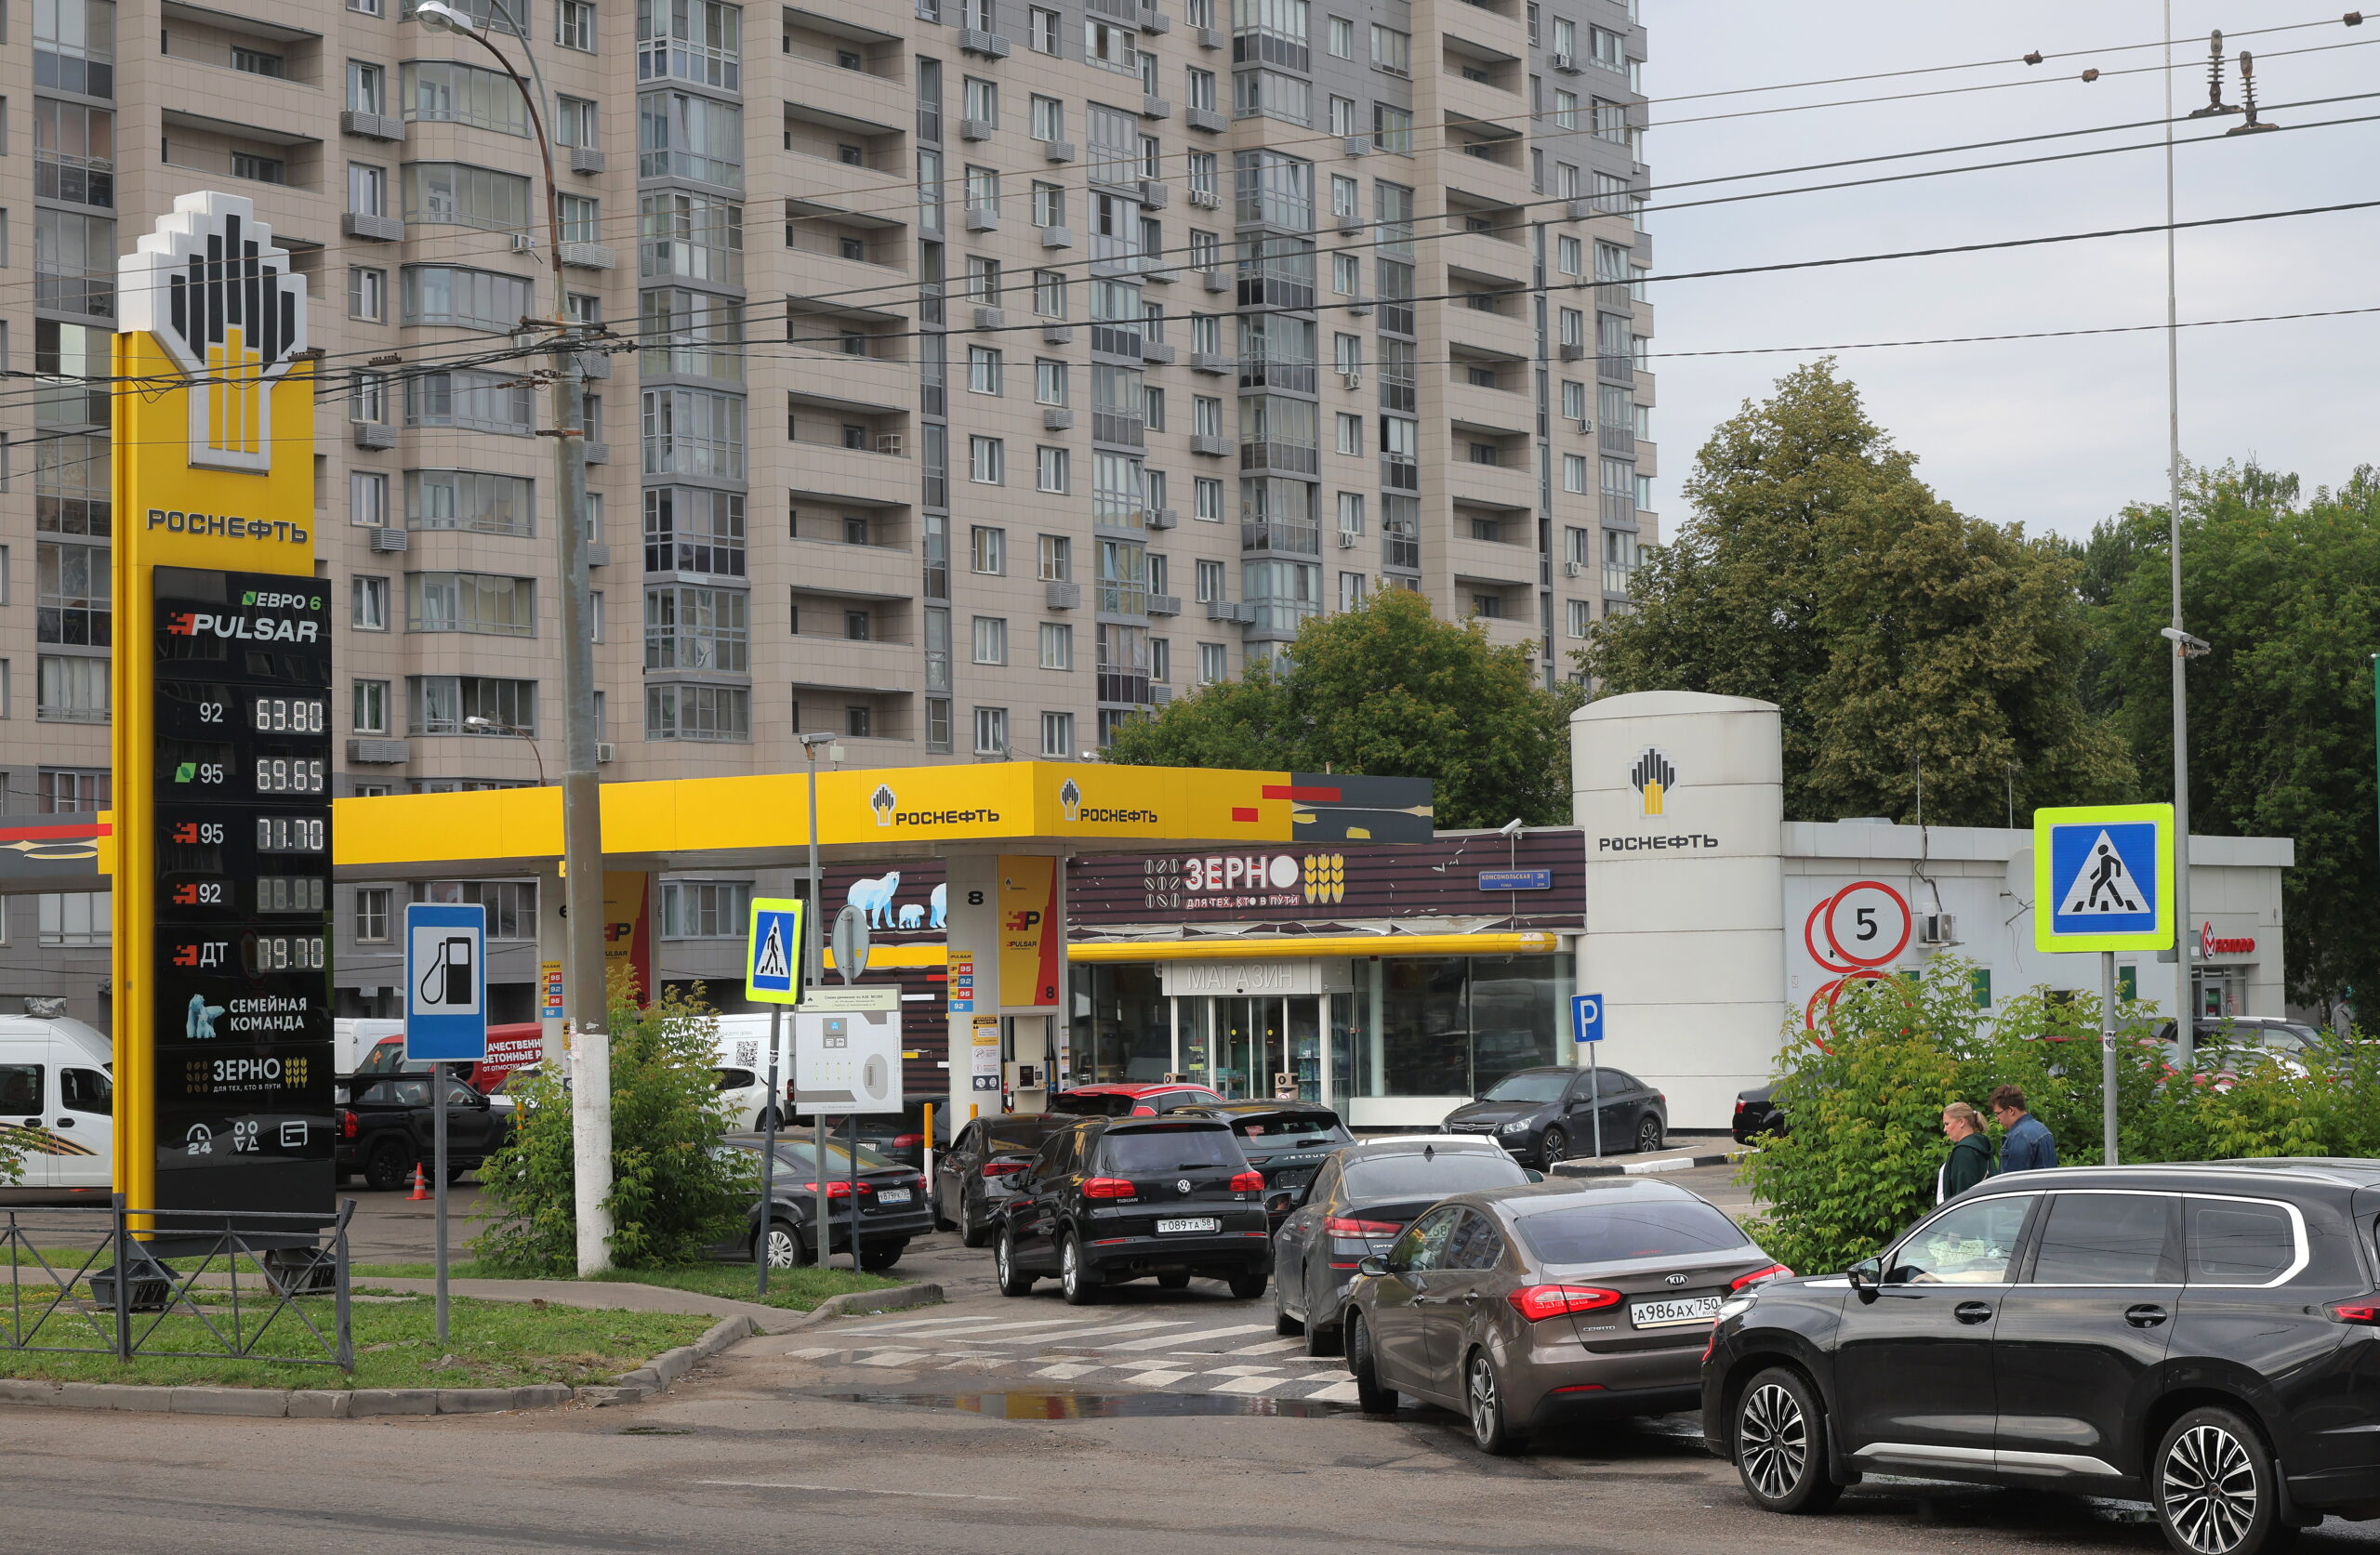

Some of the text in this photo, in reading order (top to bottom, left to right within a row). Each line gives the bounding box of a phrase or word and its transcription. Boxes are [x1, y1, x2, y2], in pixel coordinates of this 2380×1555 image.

[147, 508, 308, 544] РОСНЕФТЬ
[256, 592, 322, 611] ЕВРО 6
[192, 613, 319, 643] PULSAR
[200, 699, 323, 731] 92 63.80
[200, 759, 323, 791] 95 69.65
[895, 809, 1000, 826] РОСНЕФТЬ
[1080, 808, 1158, 824] РОСНЕФТЬ
[201, 819, 324, 850] 95 71.70
[1599, 834, 1719, 852] РОСНЕФТЬ
[1185, 855, 1300, 890] ЗЕРНО
[199, 884, 221, 903] 92
[968, 890, 984, 906] 8
[1186, 898, 1208, 909] ДЛЯ
[1236, 897, 1256, 908] КТО
[1260, 897, 1267, 905] В
[1269, 895, 1300, 906] ПУТИ
[1857, 908, 1878, 941] 5
[200, 938, 324, 969] ДТ 79.70
[1187, 964, 1294, 989] МАГАЗИН
[1045, 985, 1055, 1000] 8
[230, 995, 308, 1013] СЕМЕЙНАЯ
[231, 1015, 305, 1031] КОМАНДА
[1580, 999, 1598, 1037] P
[213, 1058, 281, 1082] ЗЕРНО
[188, 1142, 213, 1155] 24
[1201, 1219, 1211, 1227] 58
[1669, 1276, 1686, 1285] KIA
[1637, 1298, 1718, 1322] А986АХ 750
